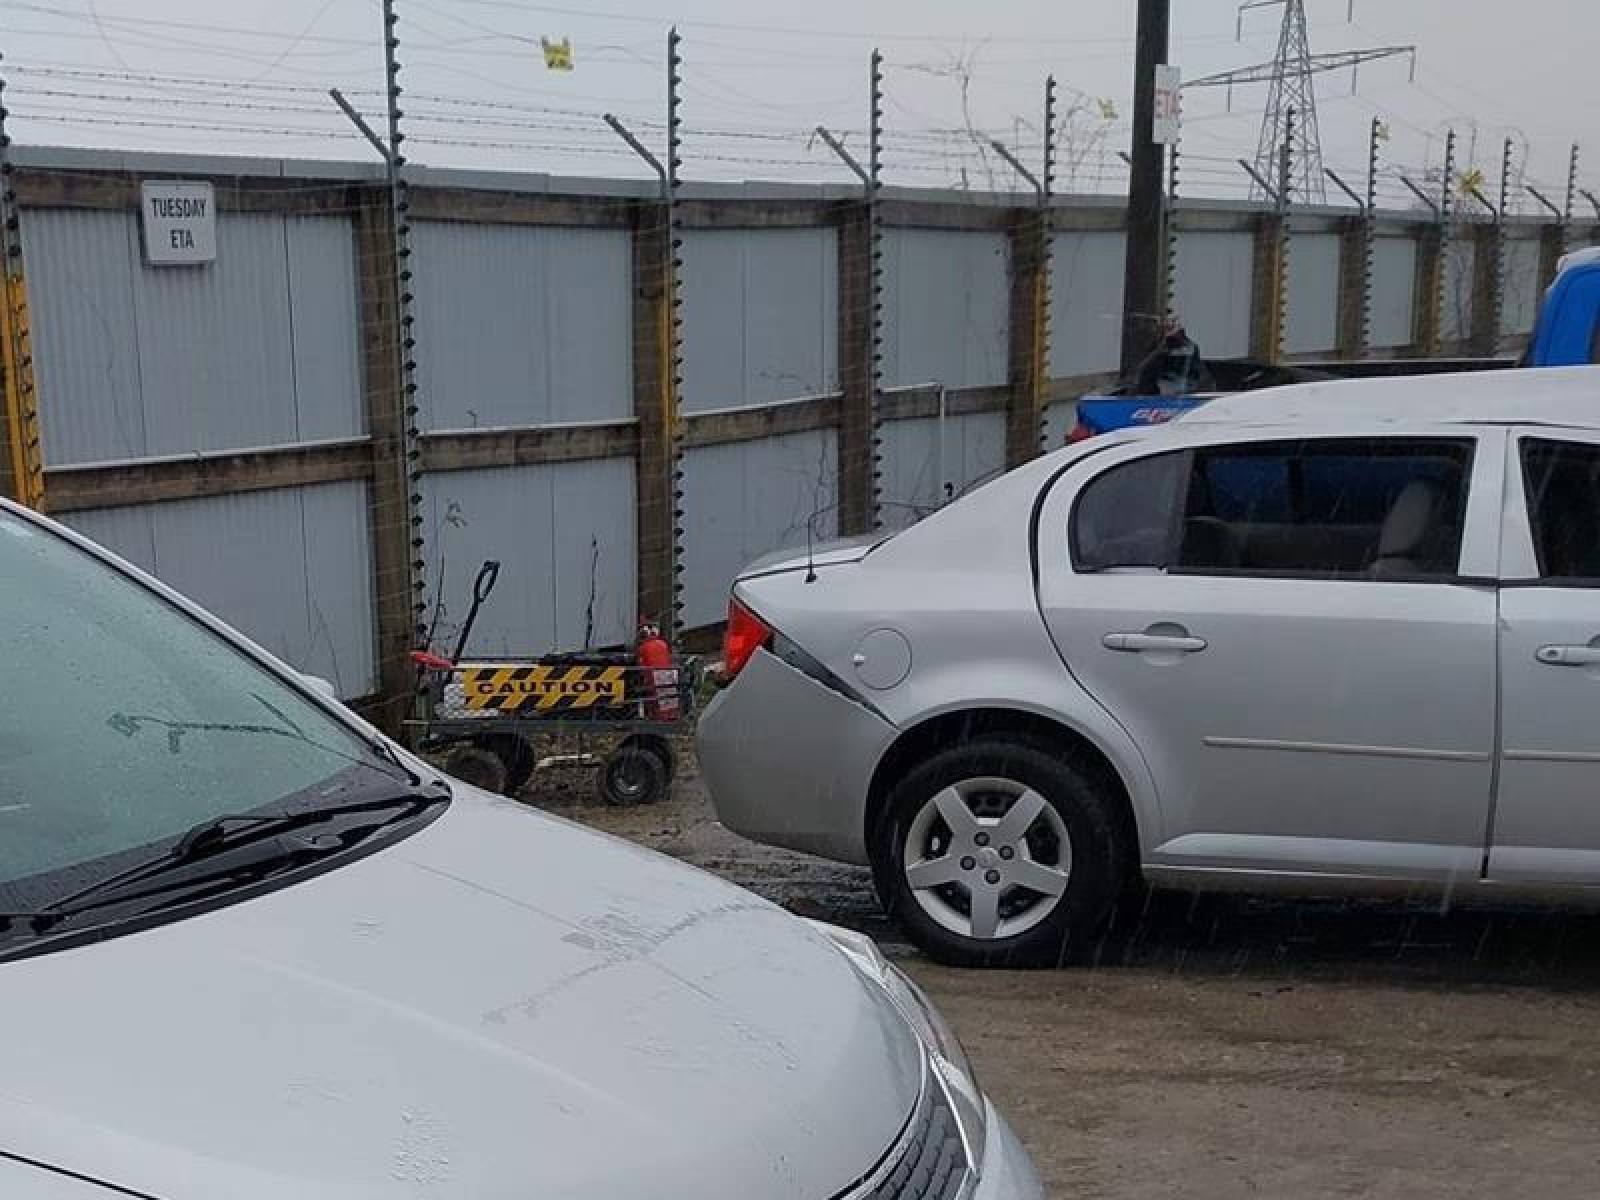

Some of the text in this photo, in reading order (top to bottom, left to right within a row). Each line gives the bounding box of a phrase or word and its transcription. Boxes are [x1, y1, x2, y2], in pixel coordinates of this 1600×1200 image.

[150, 197, 207, 218] TUESDAY
[170, 229, 195, 249] ETA
[477, 681, 613, 695] CAUTION
